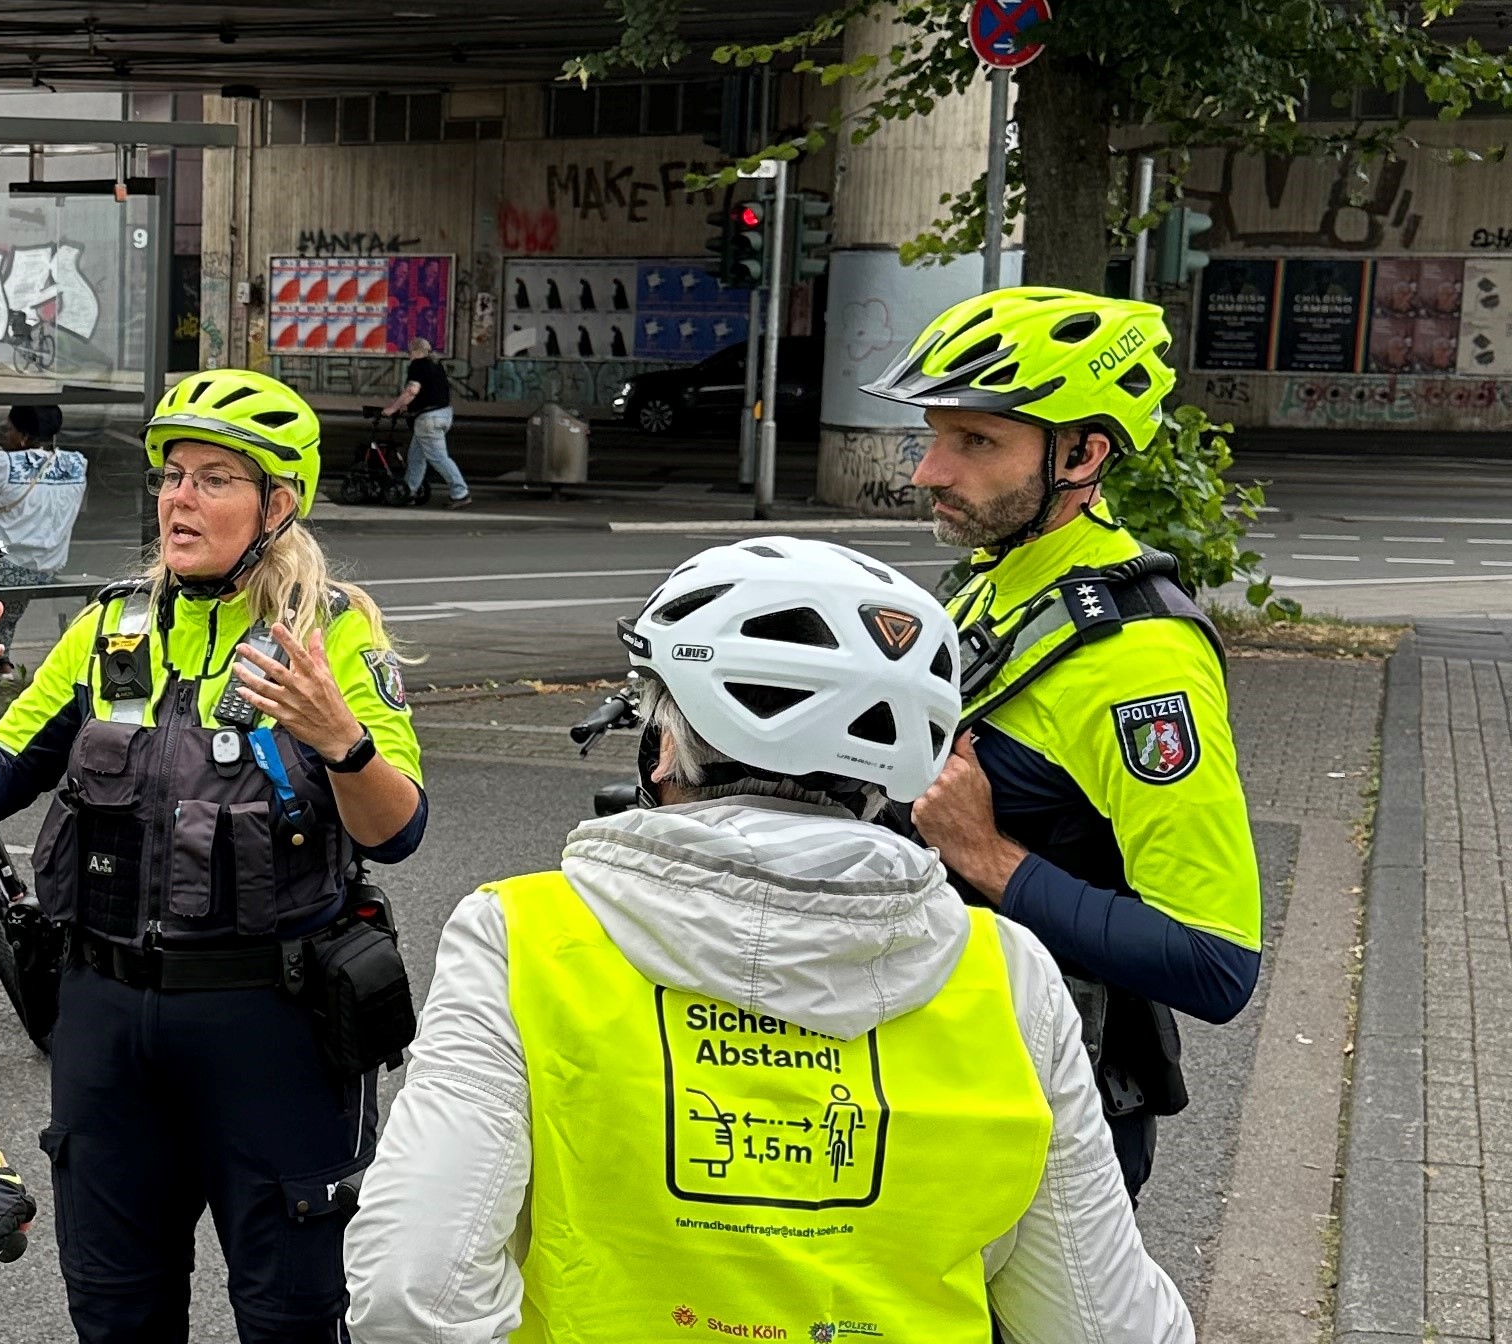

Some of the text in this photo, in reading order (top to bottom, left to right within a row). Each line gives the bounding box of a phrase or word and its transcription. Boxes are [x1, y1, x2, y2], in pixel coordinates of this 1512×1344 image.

[546, 159, 659, 223] MAKE
[133, 229, 149, 249] 9
[1088, 325, 1146, 380] POLIZEI
[1121, 700, 1184, 724] POLIZEI
[695, 1039, 842, 1074] Abstand!
[707, 1317, 788, 1340] Stadt Köln
[838, 1320, 878, 1331] POLIZEI
